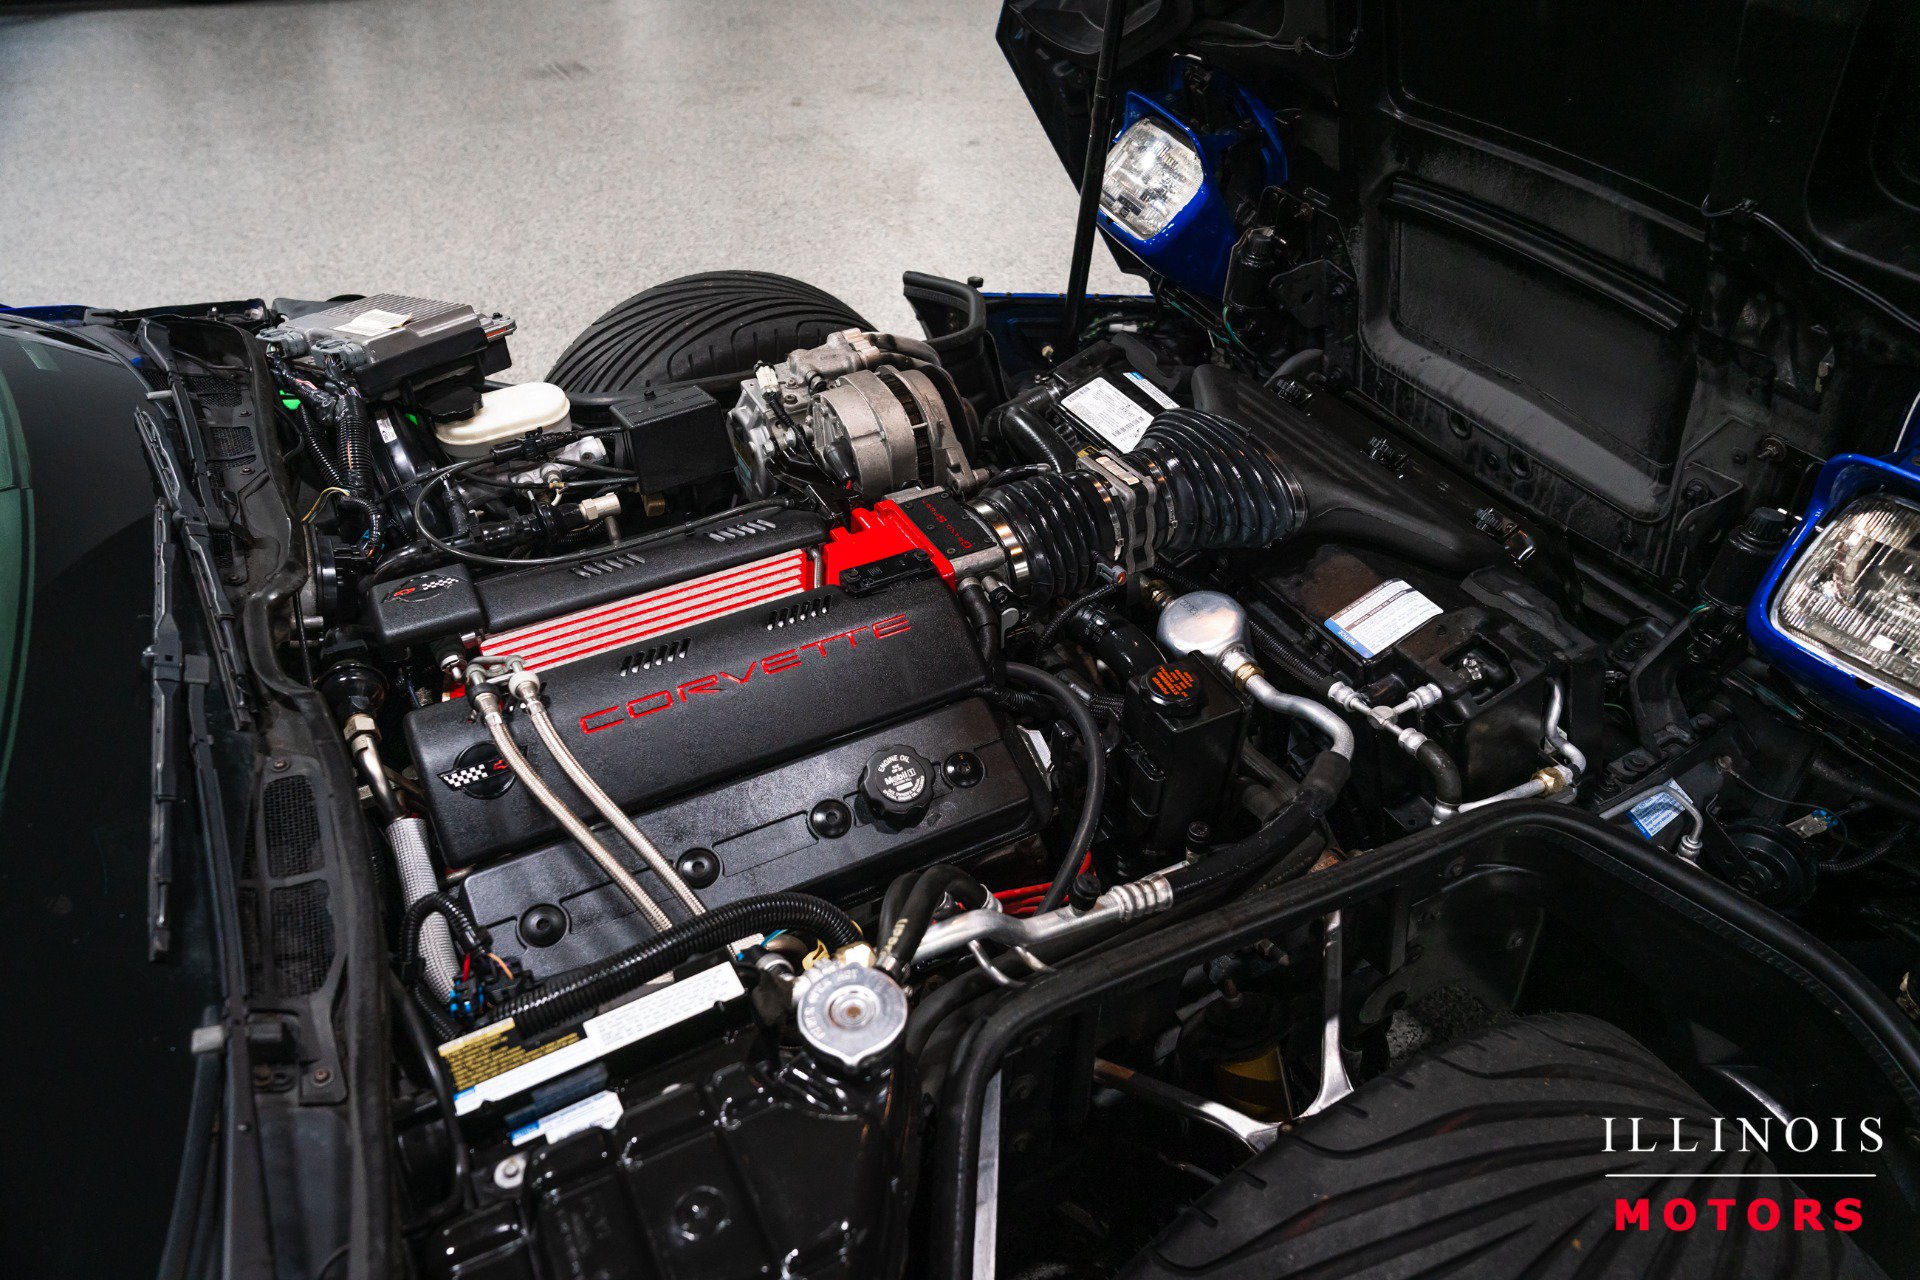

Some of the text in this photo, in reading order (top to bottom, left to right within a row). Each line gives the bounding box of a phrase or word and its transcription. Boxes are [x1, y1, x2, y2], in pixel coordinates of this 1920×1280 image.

[1337, 629, 1358, 646] NOTICE
[580, 614, 911, 735] CORVETTE
[878, 754, 910, 773] ENGINE OIL
[884, 770, 908, 786] Mobil
